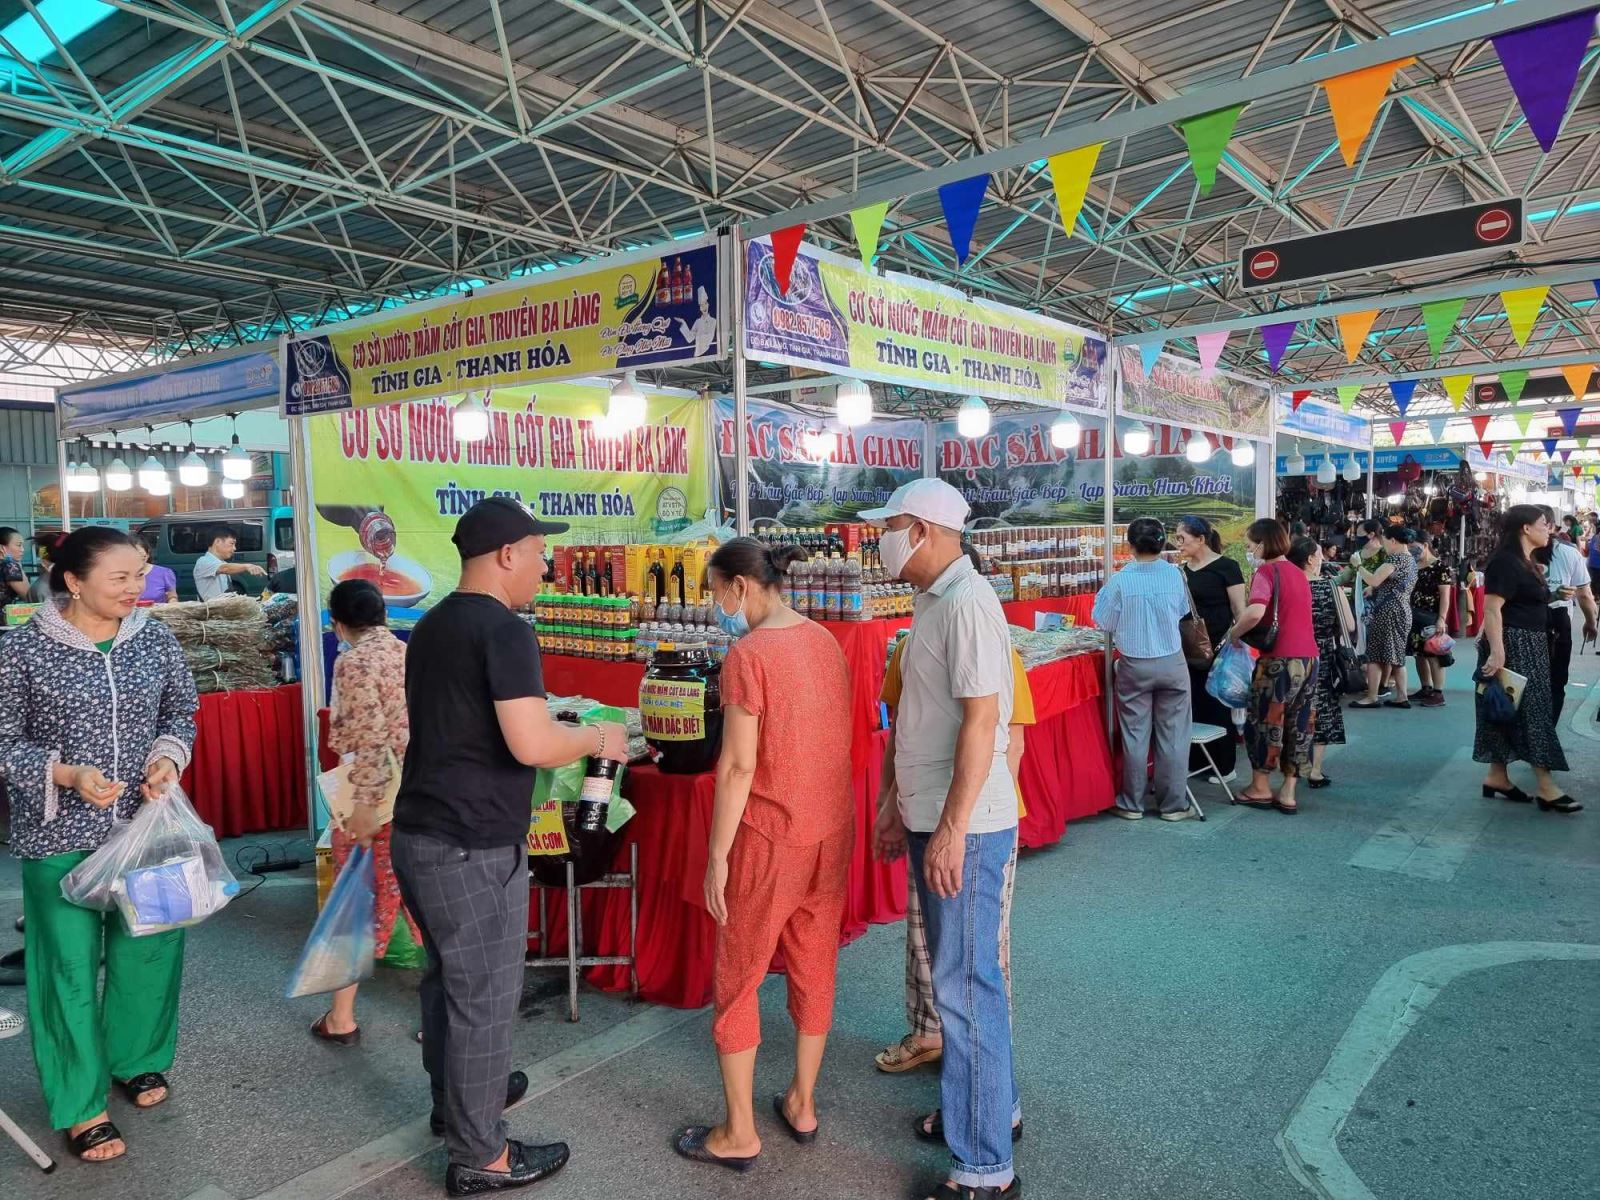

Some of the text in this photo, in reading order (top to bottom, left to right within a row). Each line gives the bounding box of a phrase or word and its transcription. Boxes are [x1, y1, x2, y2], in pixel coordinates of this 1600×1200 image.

[352, 290, 601, 369] CƠ SỞ NƯỚC MẮM CỐT GIA TRUYỀN BA LÀNG
[848, 290, 865, 324] CƠ
[868, 288, 885, 329] SỞ
[887, 299, 920, 336] NƯỚC
[950, 309, 968, 347] CỐT
[970, 321, 987, 350] GIA
[1023, 335, 1034, 361] BA
[1036, 333, 1057, 365] LÀNG
[372, 369, 409, 394] TĨNH
[413, 365, 443, 387] GIA
[456, 350, 521, 380] THANH
[527, 340, 572, 370] HÓA
[875, 337, 918, 369] TĨNH
[922, 351, 951, 374] GIA
[962, 358, 1011, 385] THANH
[1014, 366, 1042, 390] HÓA
[408, 396, 461, 464] NƯỚC
[513, 395, 544, 468] CỐT
[549, 415, 577, 470] GIA
[636, 425, 655, 474] BA
[655, 416, 689, 475] LÀNG
[862, 433, 921, 470] GIANG
[538, 490, 599, 517] THANH
[600, 488, 636, 517] HÓA
[1040, 479, 1067, 504] Bếp
[1113, 479, 1150, 498] Sườn
[1153, 477, 1189, 497] Hun
[665, 714, 681, 739] ĐẶC
[683, 714, 700, 738] BIỆT
[528, 829, 543, 850] CÁ
